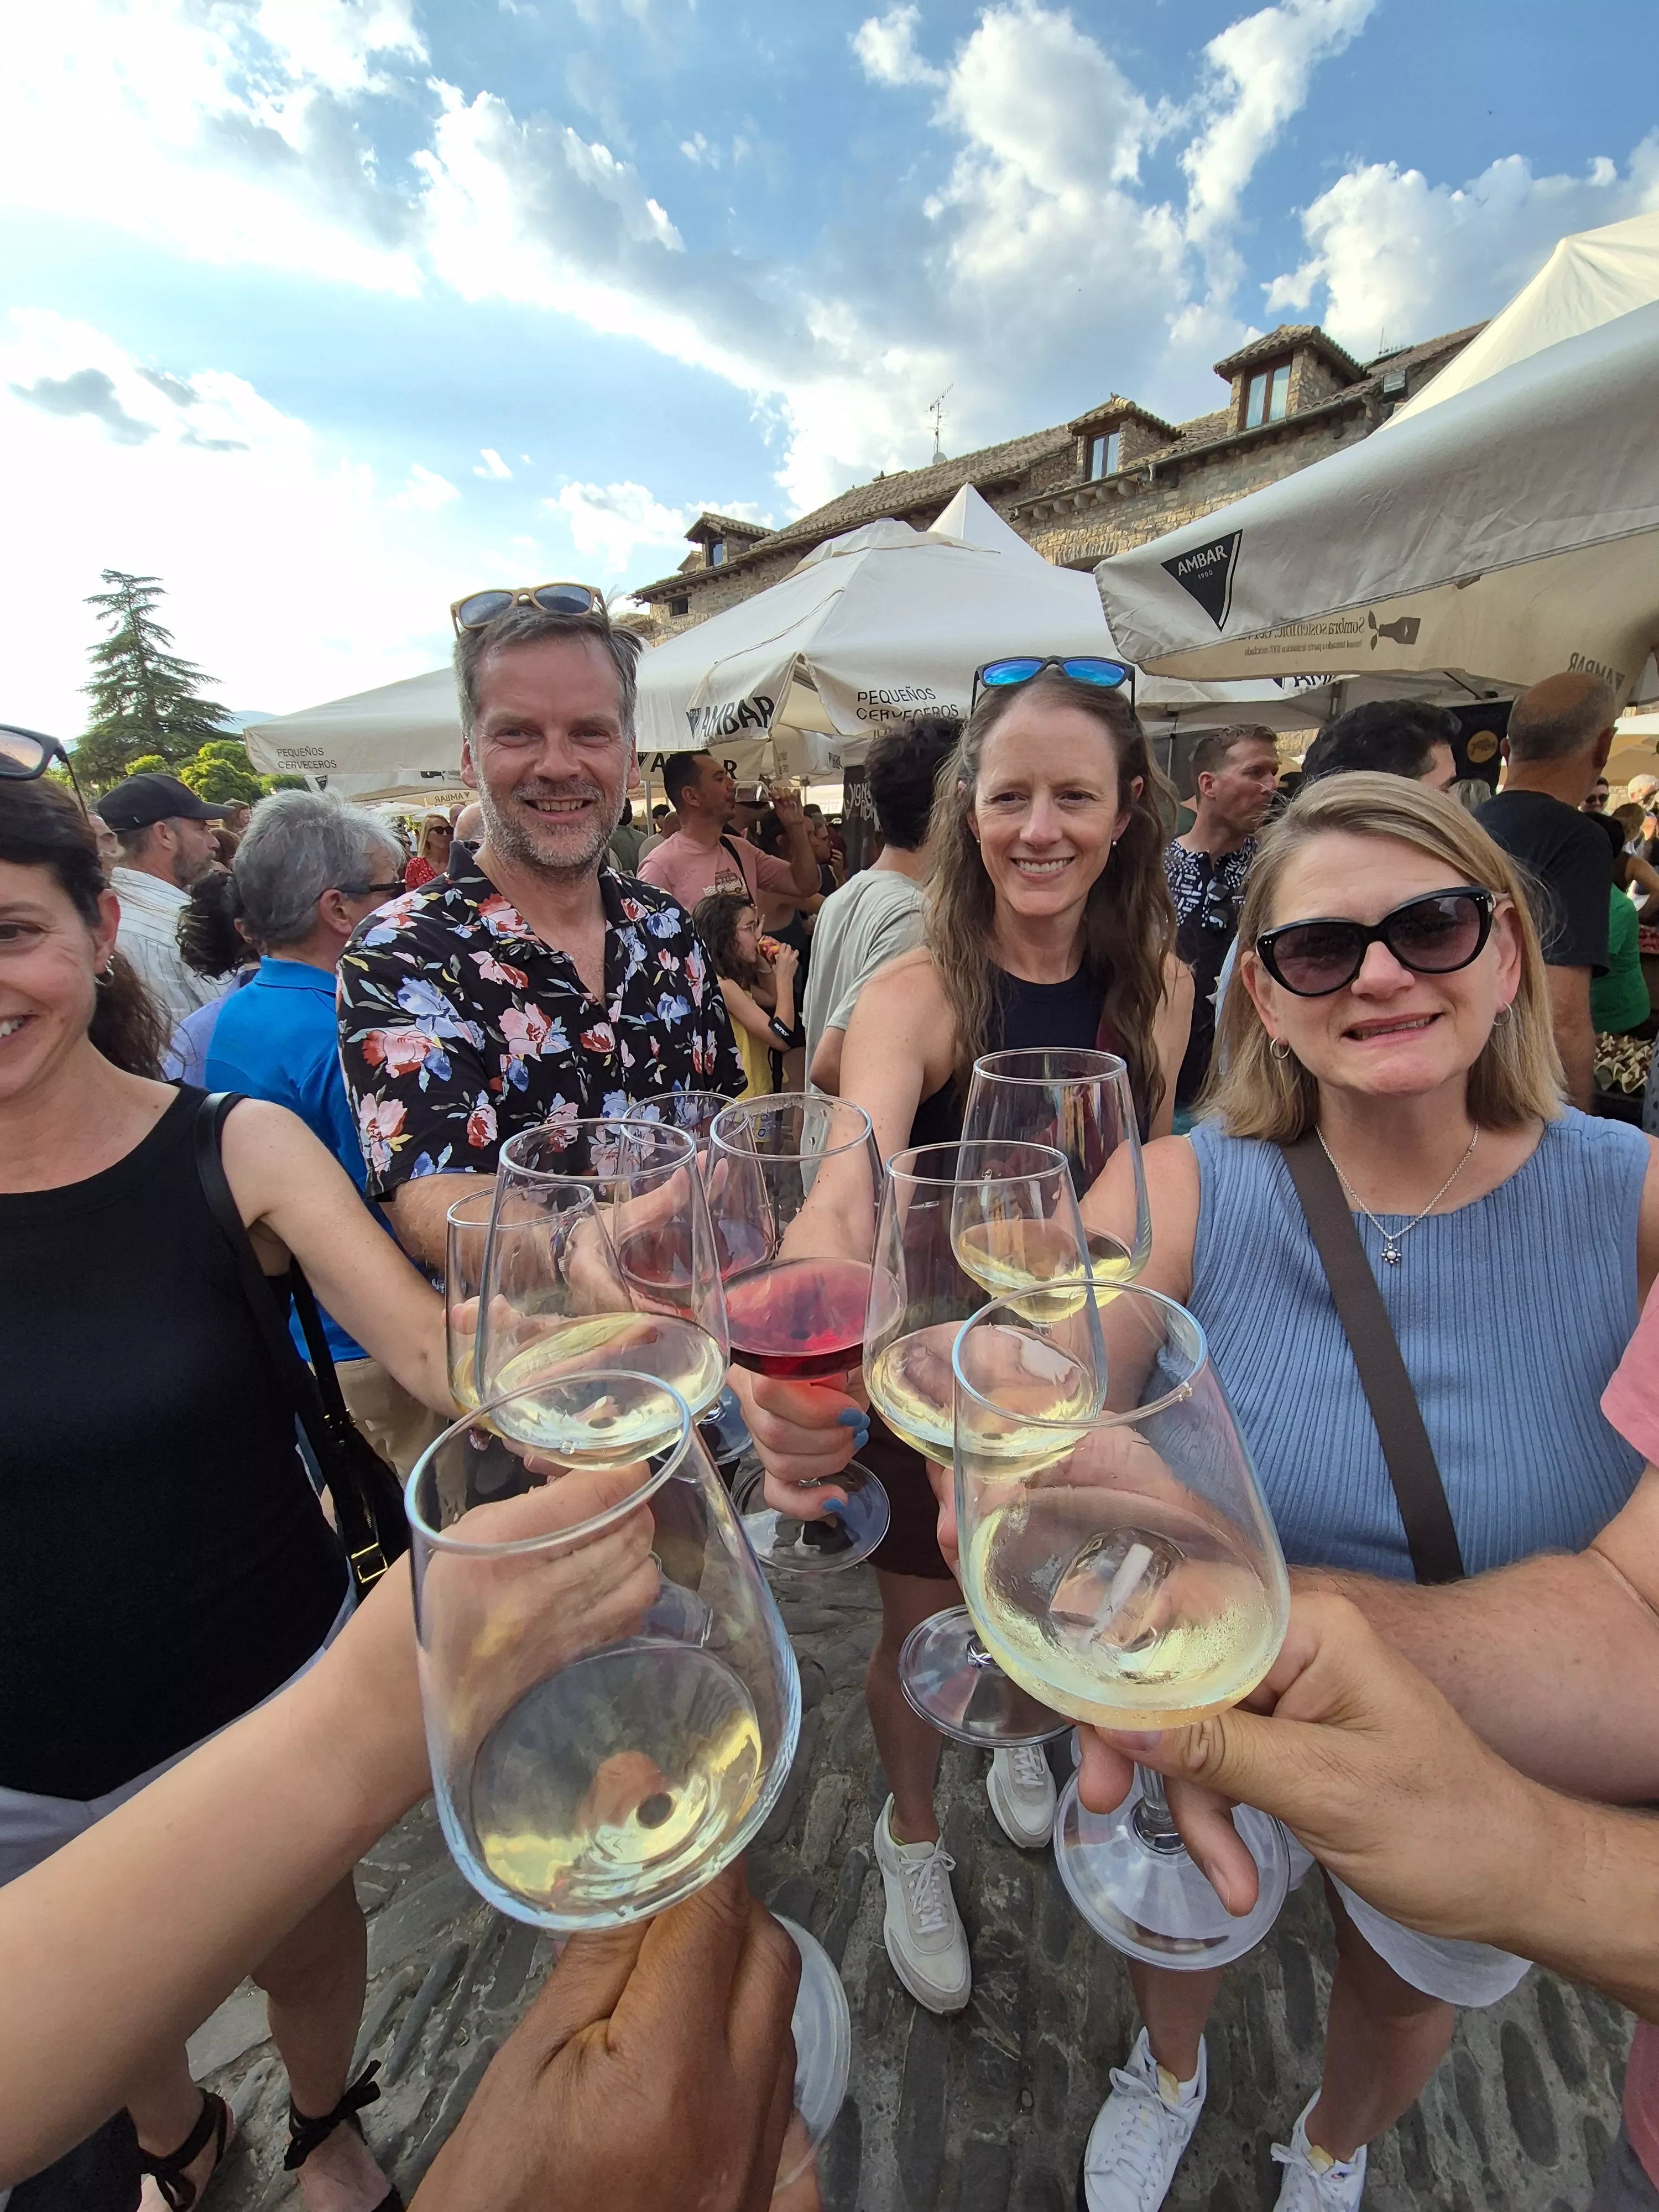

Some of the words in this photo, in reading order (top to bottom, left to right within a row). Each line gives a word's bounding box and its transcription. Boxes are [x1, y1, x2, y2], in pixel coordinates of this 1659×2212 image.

[1178, 545, 1228, 576] AMBAR
[1197, 570, 1213, 580] 1900
[857, 686, 936, 705] PEQUEÑOS
[702, 696, 775, 737] AMBAR
[277, 746, 325, 758] PEQUEÑOS
[278, 760, 337, 769] CERVECEROS
